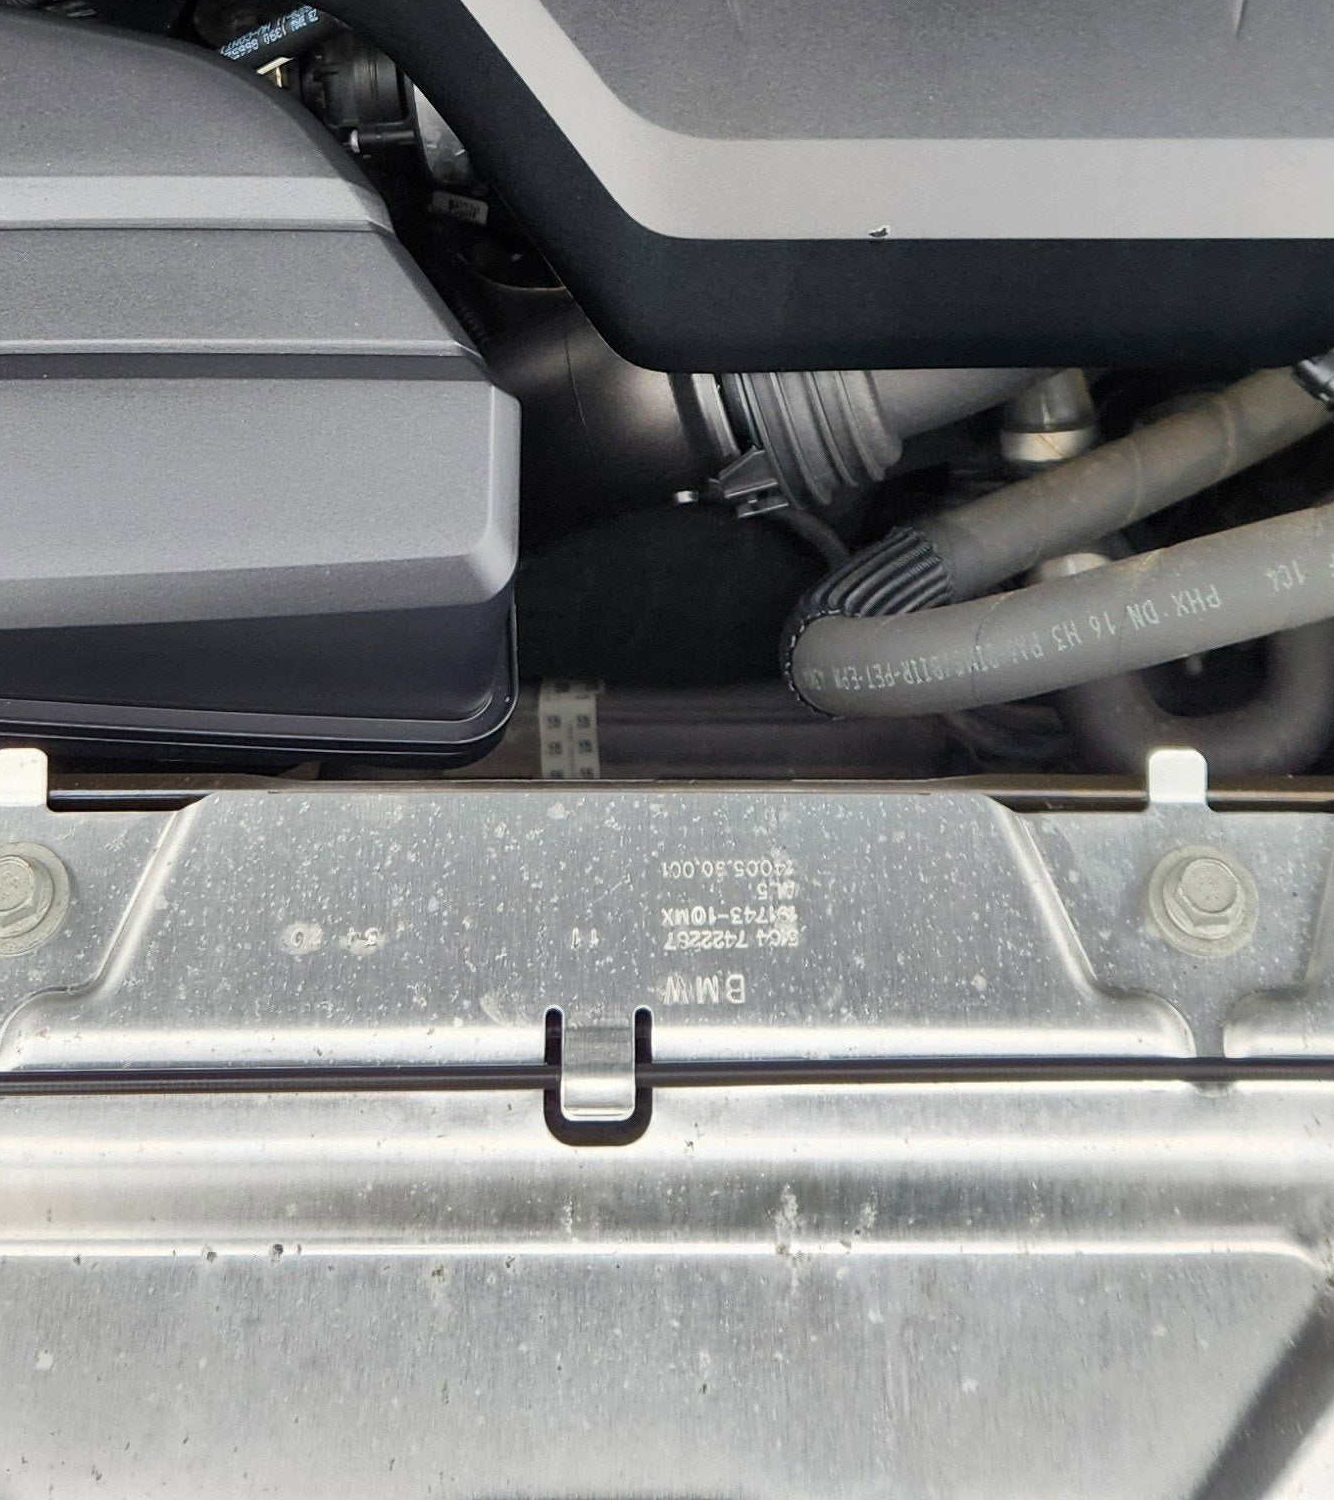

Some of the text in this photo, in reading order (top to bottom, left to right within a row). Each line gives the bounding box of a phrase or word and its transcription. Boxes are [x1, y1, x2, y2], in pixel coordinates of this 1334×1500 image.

[1127, 599, 1156, 631] DN
[1174, 583, 1223, 618] PHX
[1051, 621, 1084, 653] H3
[1088, 610, 1116, 639] 16
[663, 974, 746, 1006] BMW
